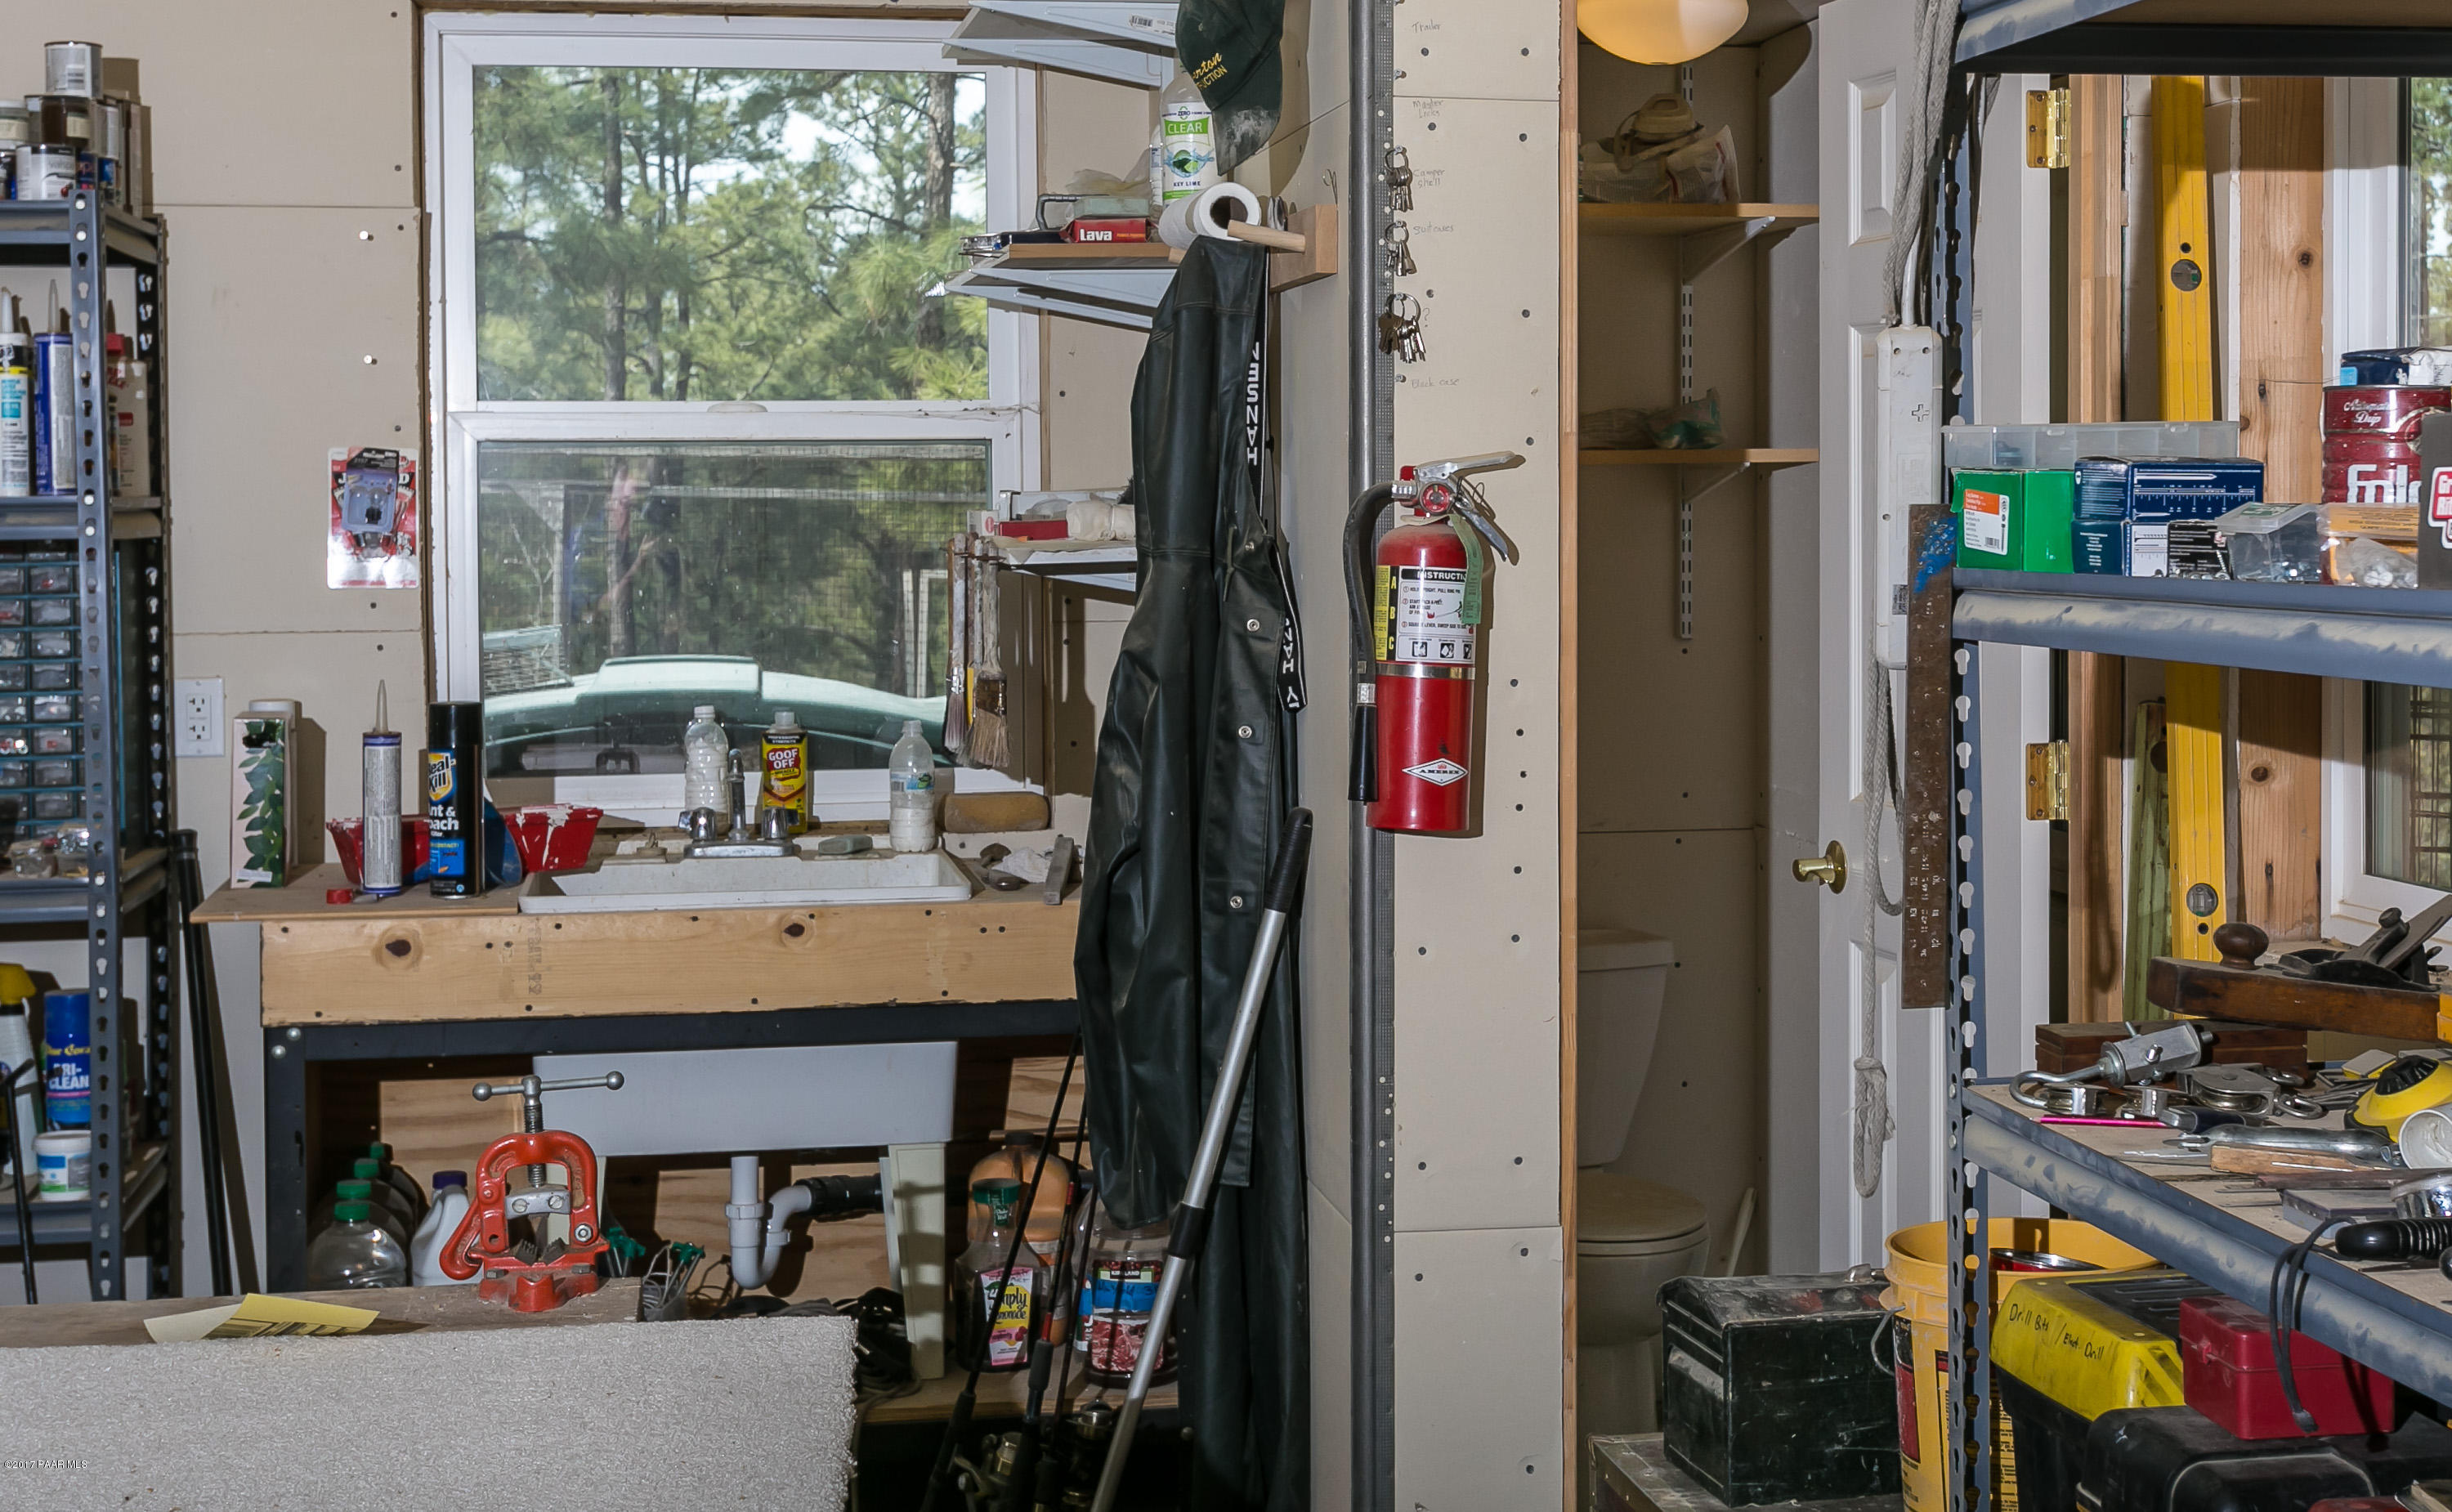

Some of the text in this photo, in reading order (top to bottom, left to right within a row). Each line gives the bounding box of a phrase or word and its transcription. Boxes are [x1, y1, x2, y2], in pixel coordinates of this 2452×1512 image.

[1167, 122, 1203, 134] CLEAR
[1080, 229, 1112, 241] Lava
[1391, 576, 1397, 589] A
[768, 749, 799, 761] GOOF
[773, 758, 795, 769] OFF
[445, 806, 456, 817] &
[2009, 1303, 2033, 1326] Drill
[2084, 1341, 2105, 1360] Drill
